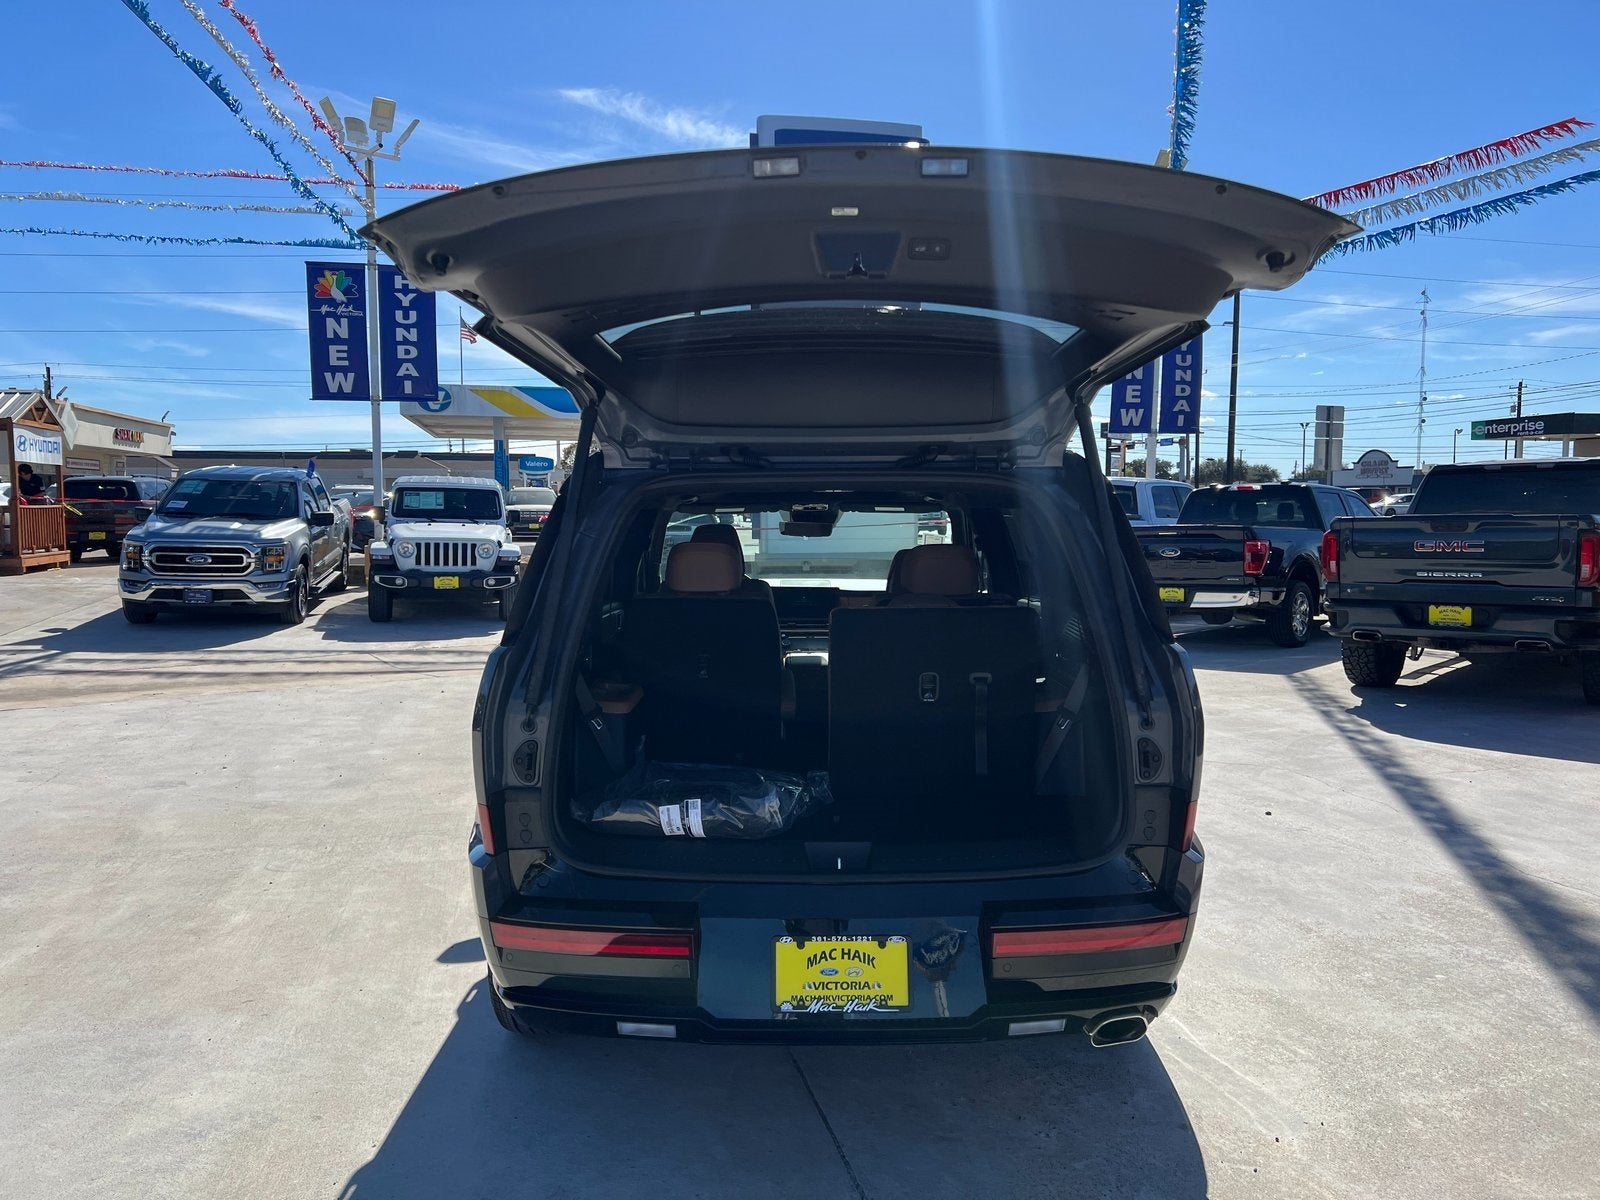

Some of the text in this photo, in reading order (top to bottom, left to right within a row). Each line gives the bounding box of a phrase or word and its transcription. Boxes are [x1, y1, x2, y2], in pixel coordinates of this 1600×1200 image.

[394, 275, 420, 394] HYUNDAI
[324, 317, 355, 393] NEW
[1172, 339, 1192, 427] YUNDAI
[1473, 420, 1545, 435] enterprise
[29, 438, 61, 455] HYUNDAI
[1414, 540, 1485, 553] GMC
[806, 948, 877, 970] MAC HAIK
[812, 981, 871, 991] VICTORIA
[806, 998, 880, 1013] Mac Haik
